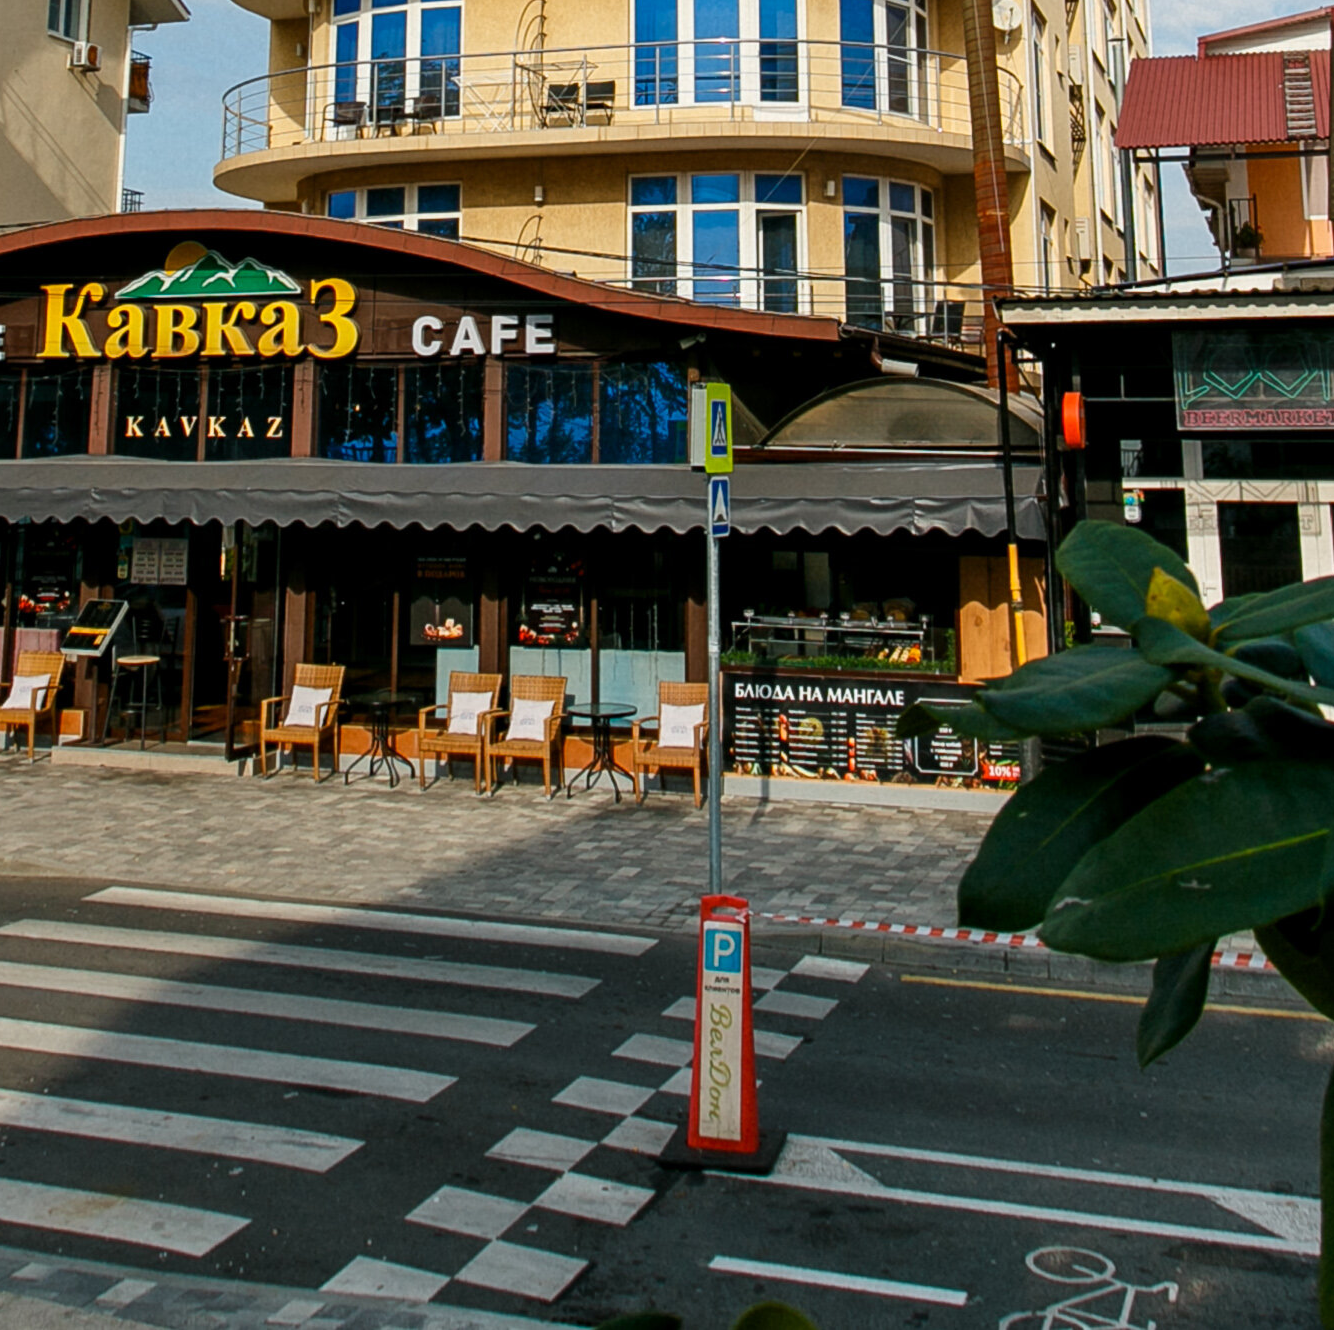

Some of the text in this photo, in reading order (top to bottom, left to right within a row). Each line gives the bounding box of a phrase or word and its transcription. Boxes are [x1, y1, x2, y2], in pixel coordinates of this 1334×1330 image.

[411, 314, 555, 357] CAFE
[125, 415, 284, 439] KAVKAZ
[734, 683, 905, 706] БЛЮДА НА МАНГАЛЕ
[989, 766, 1011, 777] 10%
[714, 932, 736, 967] P
